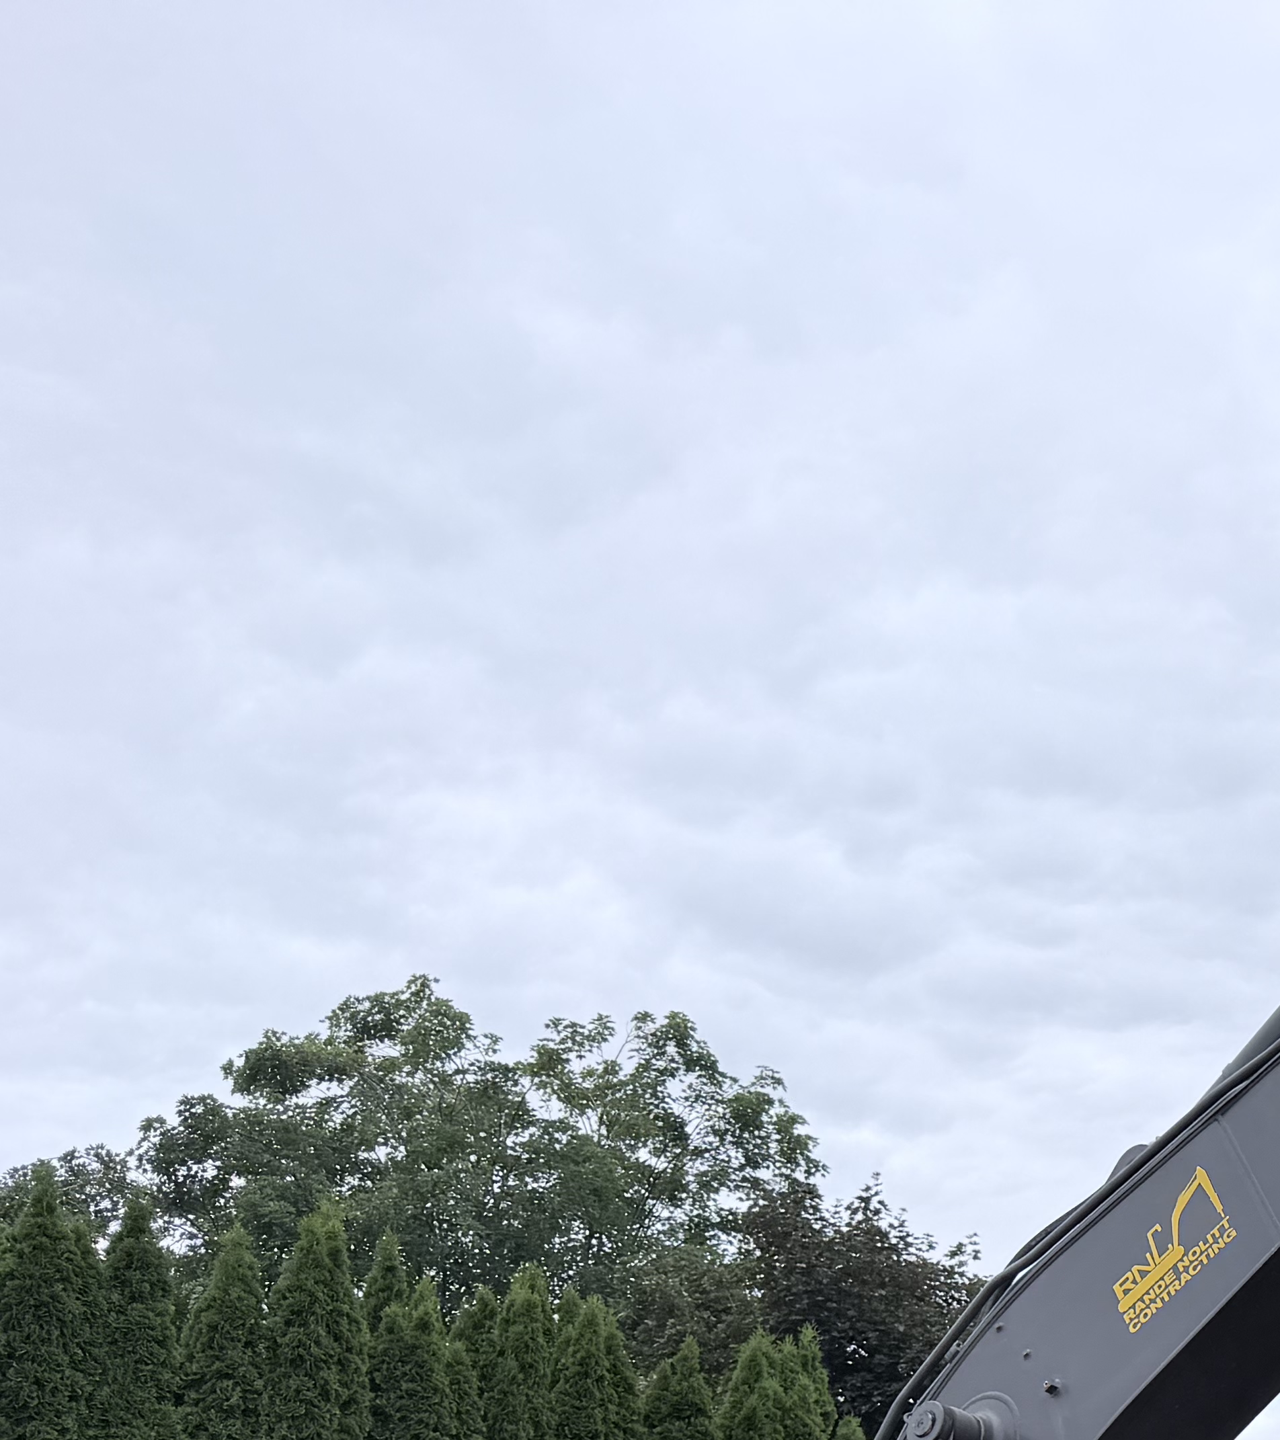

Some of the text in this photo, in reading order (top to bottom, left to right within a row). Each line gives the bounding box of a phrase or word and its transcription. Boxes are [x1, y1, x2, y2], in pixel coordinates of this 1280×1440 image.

[1123, 1216, 1231, 1325] RANDE NOLITT
[1128, 1228, 1238, 1334] CONTRACTING
